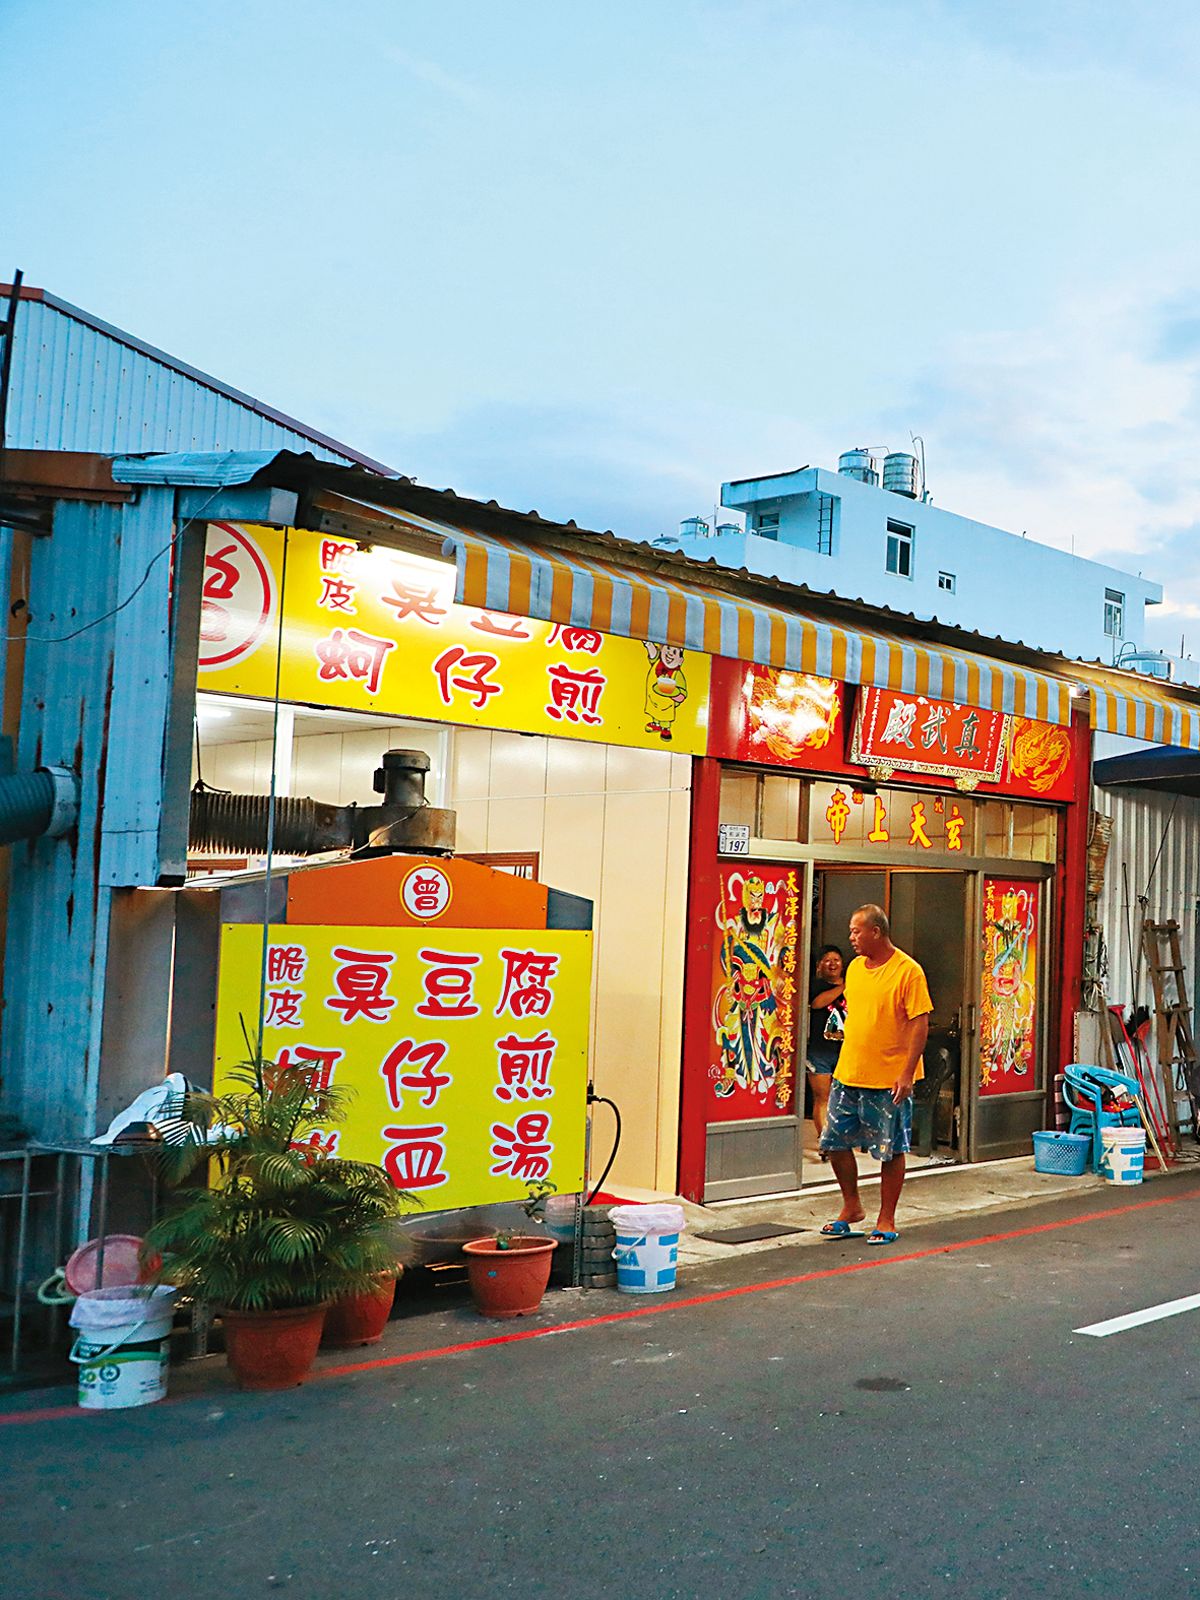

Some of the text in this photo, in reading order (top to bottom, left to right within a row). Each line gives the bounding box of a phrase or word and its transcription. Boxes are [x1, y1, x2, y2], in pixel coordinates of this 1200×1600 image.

[316, 630, 606, 724] 蚵仔煎
[879, 698, 982, 761] 真武殿
[729, 840, 746, 852] 197
[412, 873, 441, 912] 曾
[265, 946, 304, 1027] 脆皮
[326, 948, 559, 1021] 臭豆腐
[287, 1113, 553, 1189] 血湯
